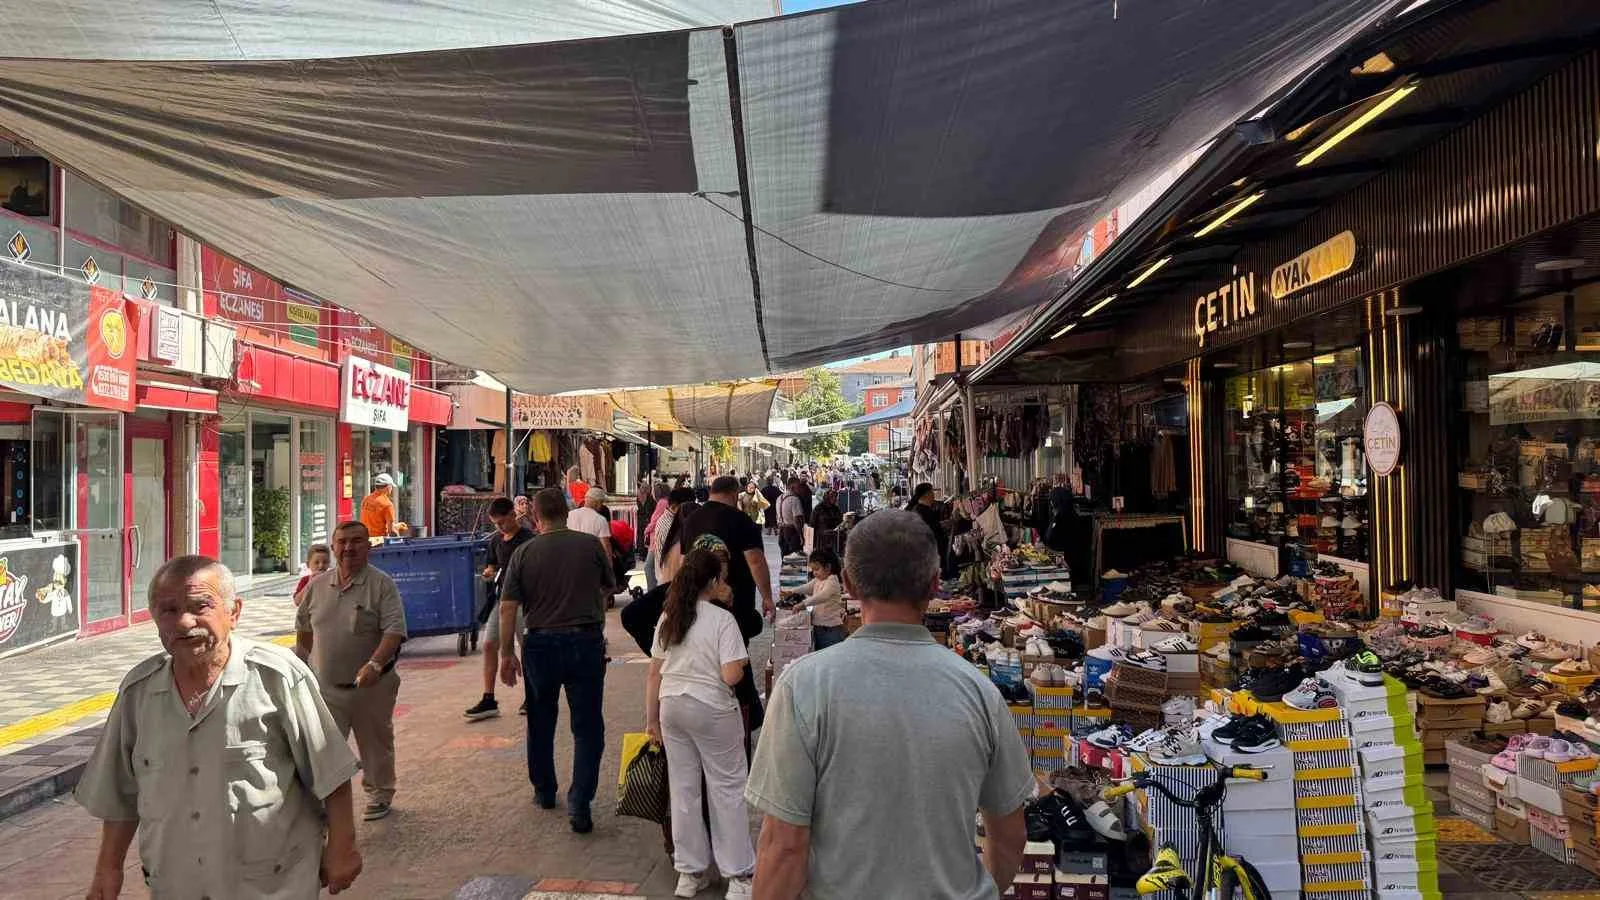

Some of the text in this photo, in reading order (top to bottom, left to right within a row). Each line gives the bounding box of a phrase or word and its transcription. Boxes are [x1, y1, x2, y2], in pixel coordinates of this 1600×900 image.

[233, 263, 253, 290] ŞİFA
[1273, 235, 1353, 297] AYAKK
[1195, 265, 1255, 347] ÇETİN
[352, 364, 409, 410] ECZANE
[530, 410, 564, 418] BAYAN
